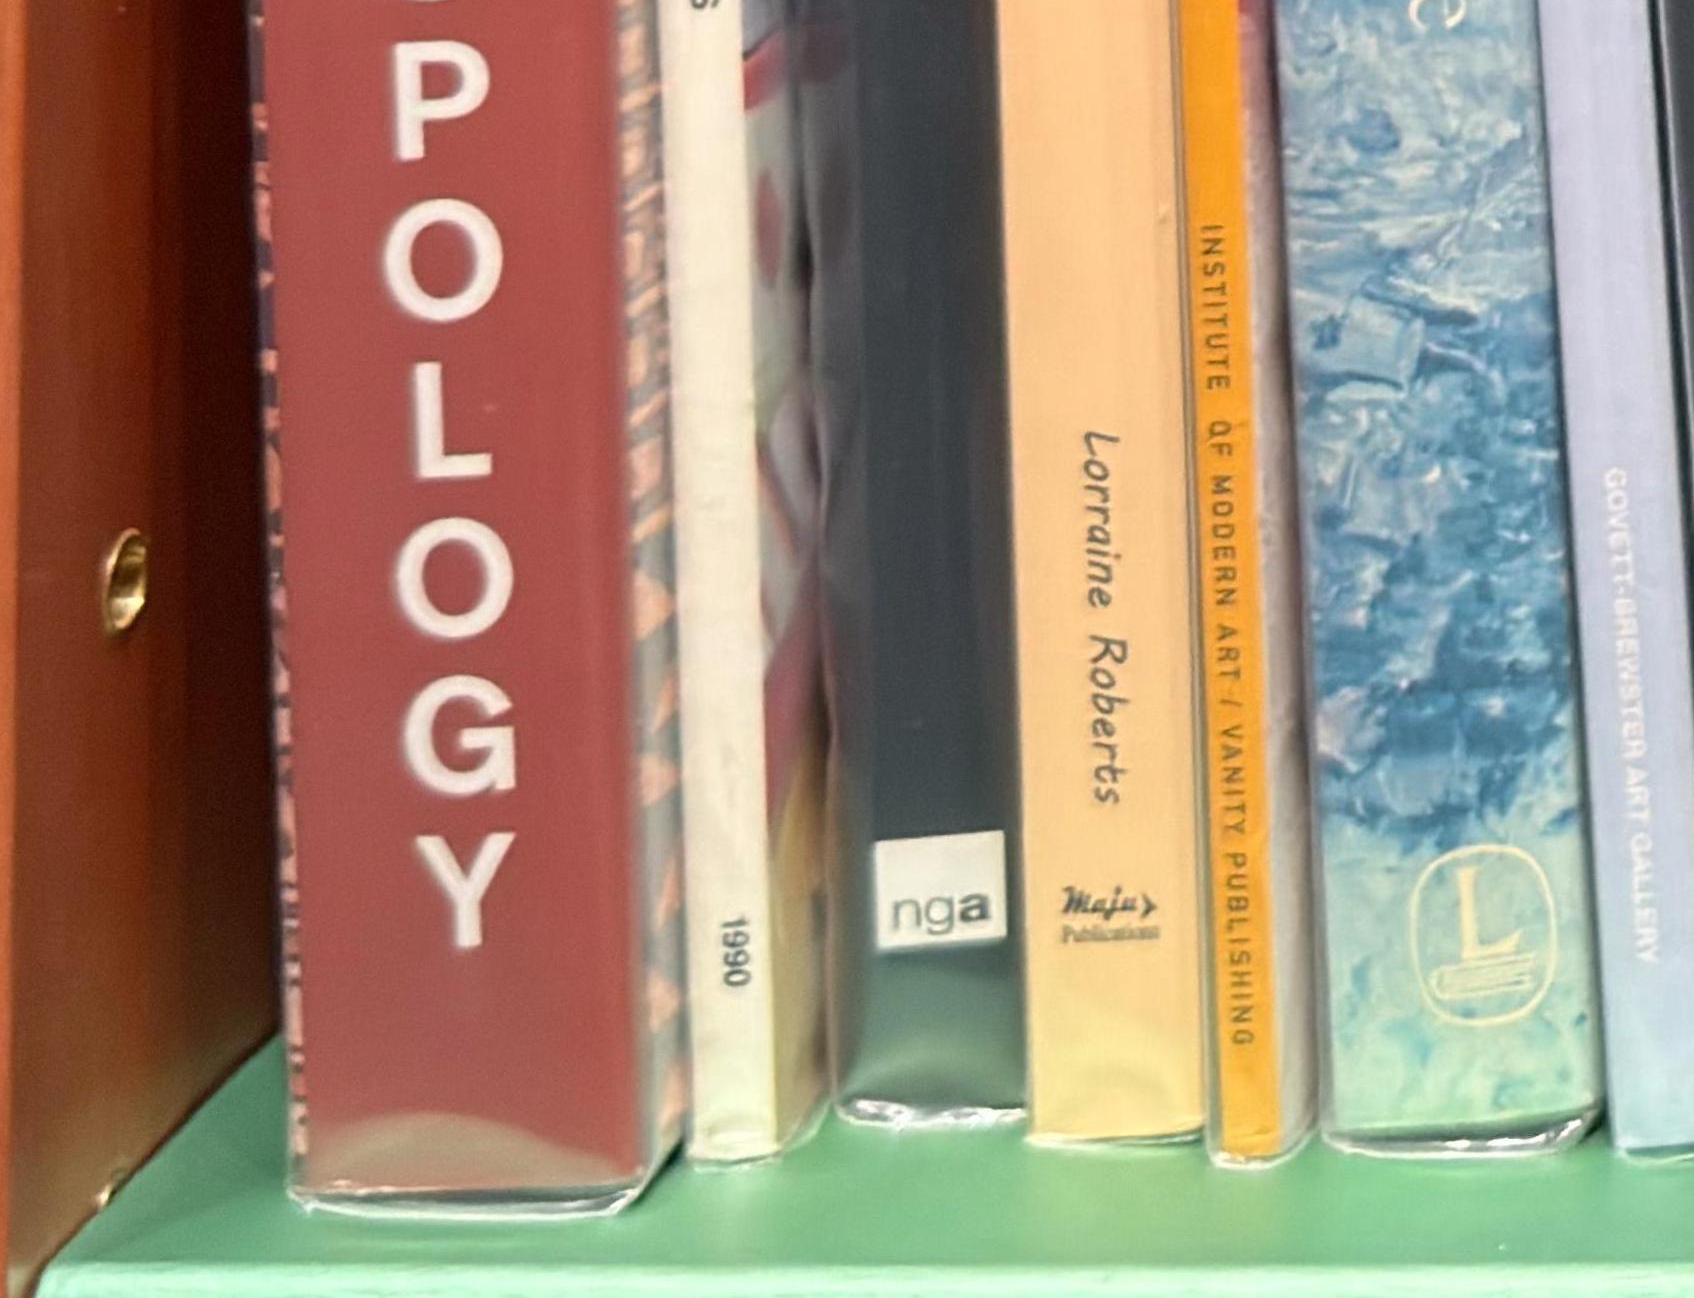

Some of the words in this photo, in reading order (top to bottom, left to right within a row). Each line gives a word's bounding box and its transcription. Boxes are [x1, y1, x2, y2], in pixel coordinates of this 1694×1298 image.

[1201, 223, 1230, 390] INSTITUTE
[1208, 420, 1233, 457] OF
[1084, 430, 1122, 608] Lorraine
[1211, 474, 1239, 607] MODERN
[1216, 624, 1241, 681] ART
[1089, 634, 1128, 805] Roberts
[1220, 724, 1246, 835] VANITY
[1625, 766, 1650, 822] ART
[720, 916, 751, 986] 1990
[892, 886, 992, 935] nga
[1224, 853, 1255, 1046] PUBLISHING
